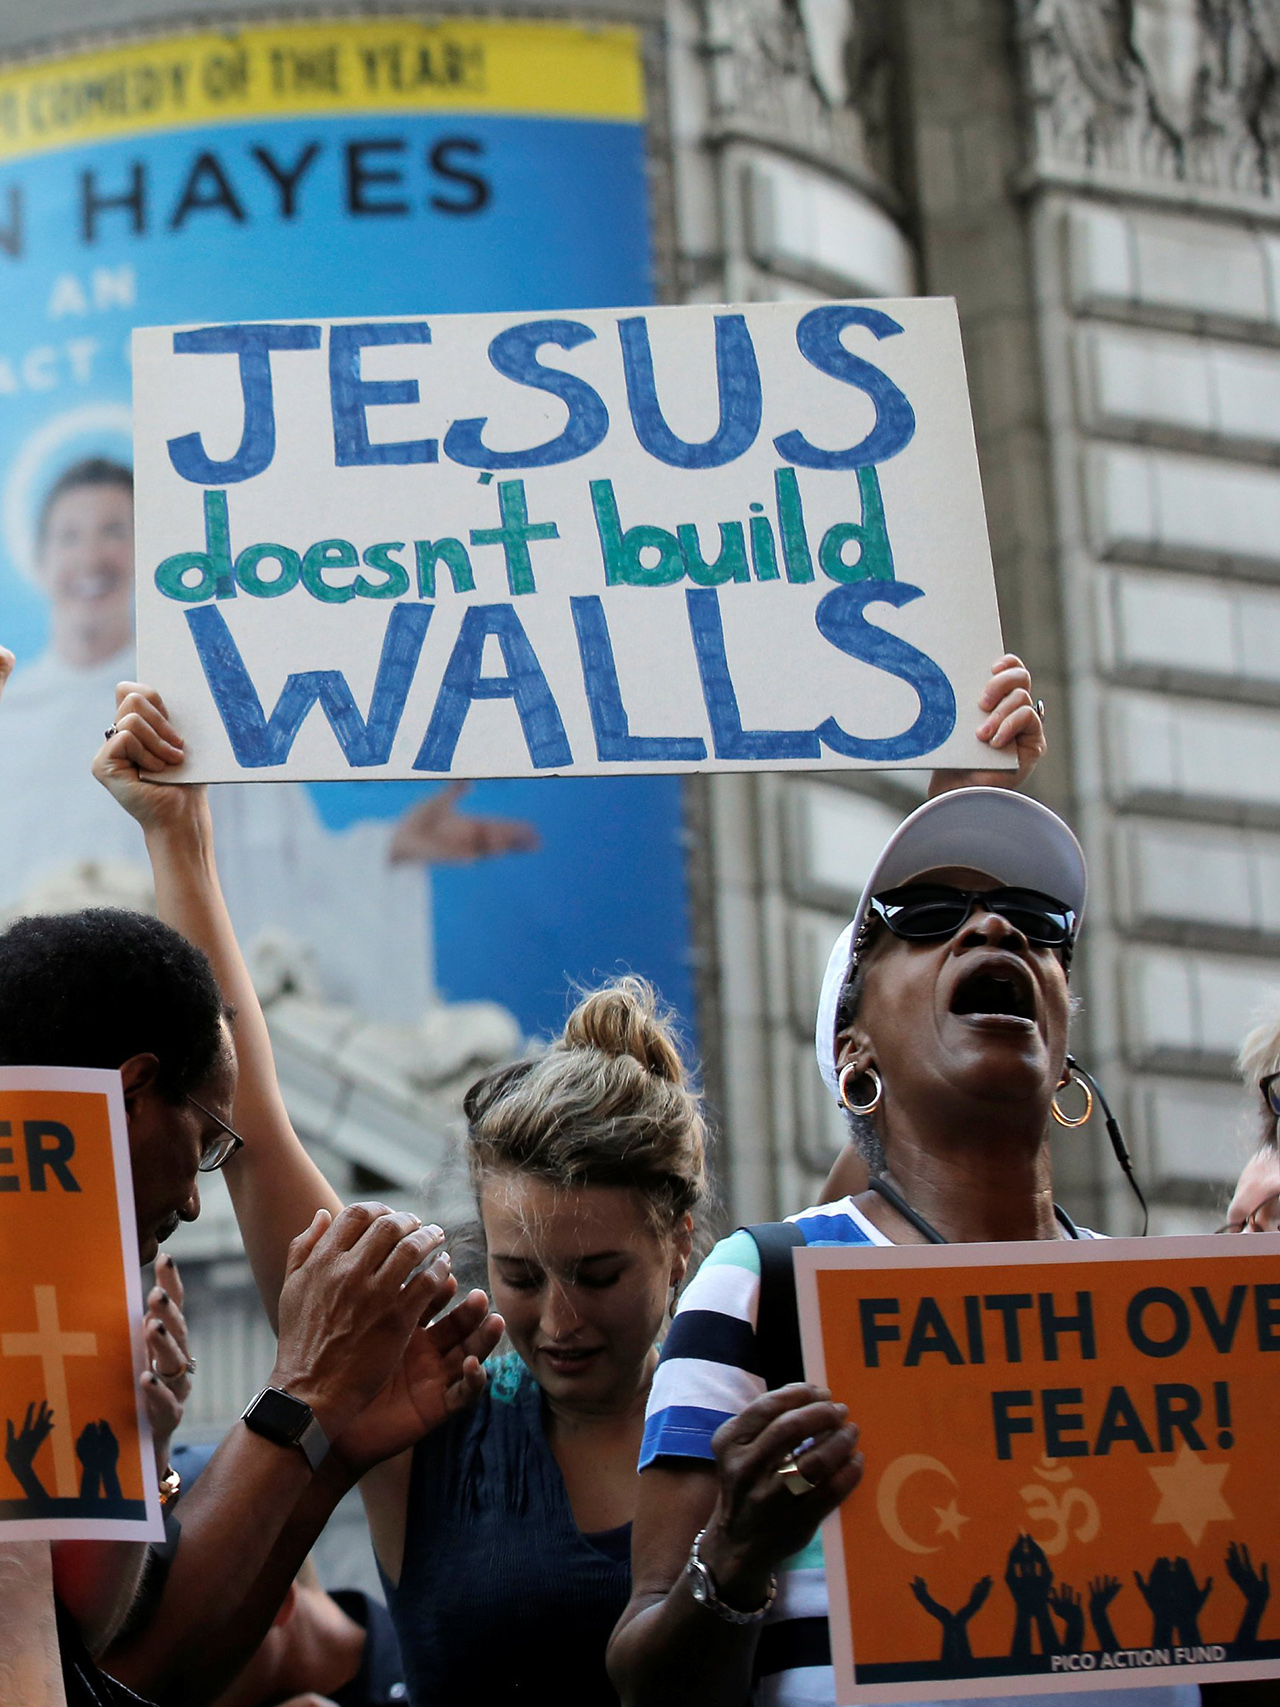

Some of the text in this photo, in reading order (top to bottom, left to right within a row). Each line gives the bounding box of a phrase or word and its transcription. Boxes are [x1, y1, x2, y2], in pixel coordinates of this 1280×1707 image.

[29, 62, 190, 136] COMEDY
[202, 46, 250, 104] OF
[269, 45, 341, 96] THE
[358, 40, 488, 96] YEAR!
[78, 136, 494, 246] HAYES
[48, 265, 138, 319] AN
[166, 305, 917, 486] JESUS
[588, 463, 897, 588] build
[183, 579, 958, 772] WALLS
[858, 1282, 1280, 1369] FAITH OVE
[990, 1381, 1236, 1461] FEAR!
[1050, 1645, 1227, 1673] PICO ACTION FUND
